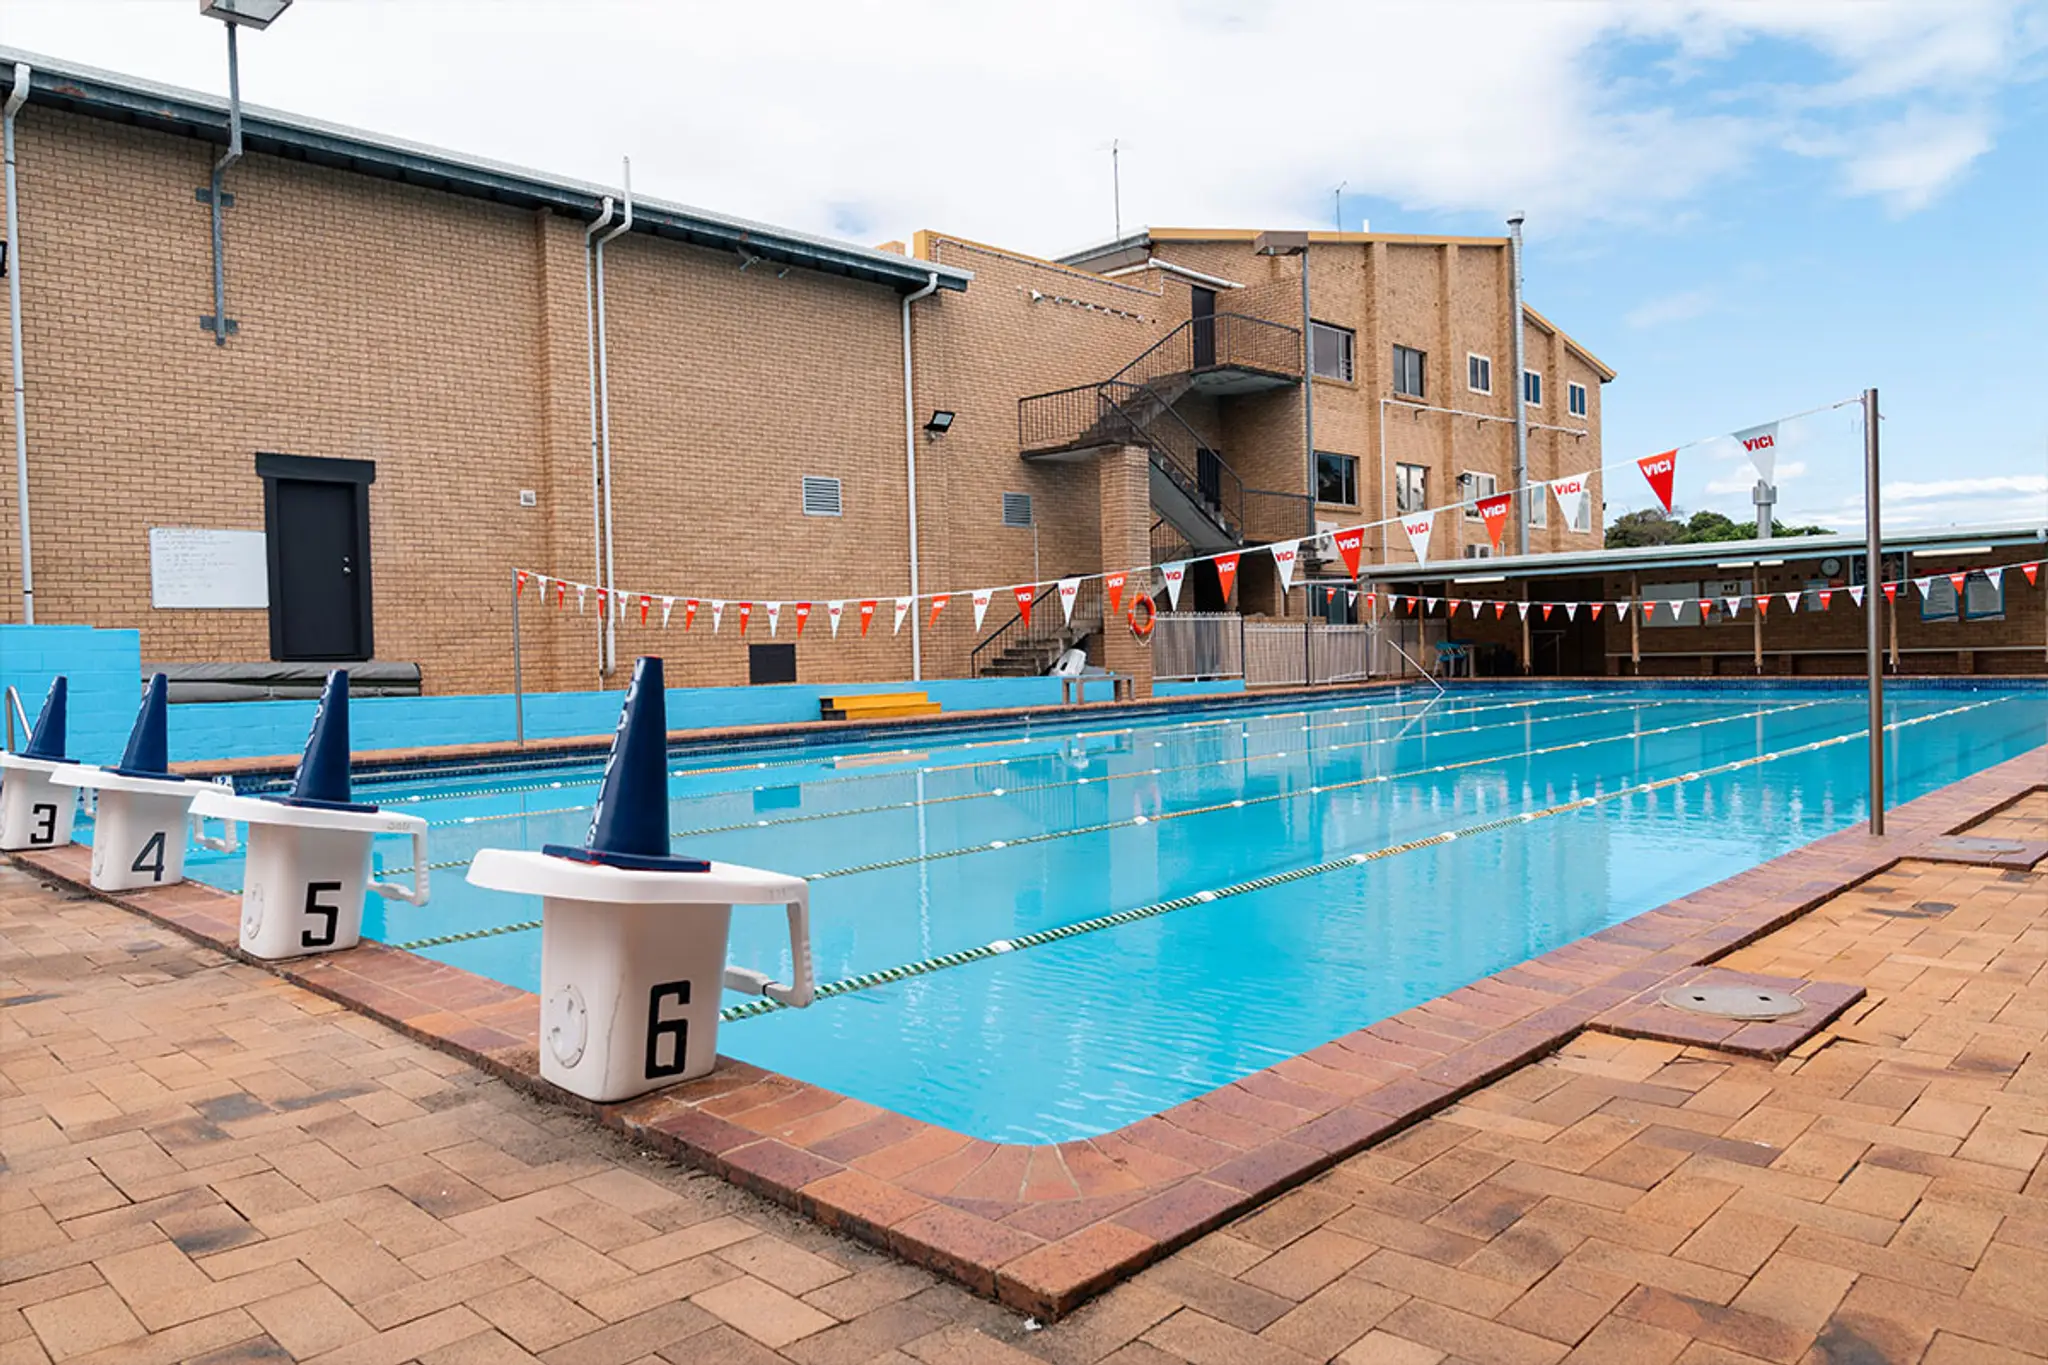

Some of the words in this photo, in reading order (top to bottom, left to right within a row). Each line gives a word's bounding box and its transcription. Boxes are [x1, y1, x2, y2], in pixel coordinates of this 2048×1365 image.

[1743, 434, 1774, 452] VICI
[1643, 459, 1672, 477] VICI
[1555, 481, 1582, 496] VICI
[1482, 503, 1507, 519] VICI
[1406, 521, 1429, 536] VICI
[1338, 537, 1361, 551] VICI
[1275, 550, 1295, 563] VICI
[1217, 560, 1236, 573] VICI
[1107, 576, 1124, 588] VICI
[1165, 570, 1182, 581] VICI
[30, 803, 57, 844] 3
[131, 832, 165, 882] 4
[302, 882, 342, 947] 5
[645, 980, 691, 1079] 6
